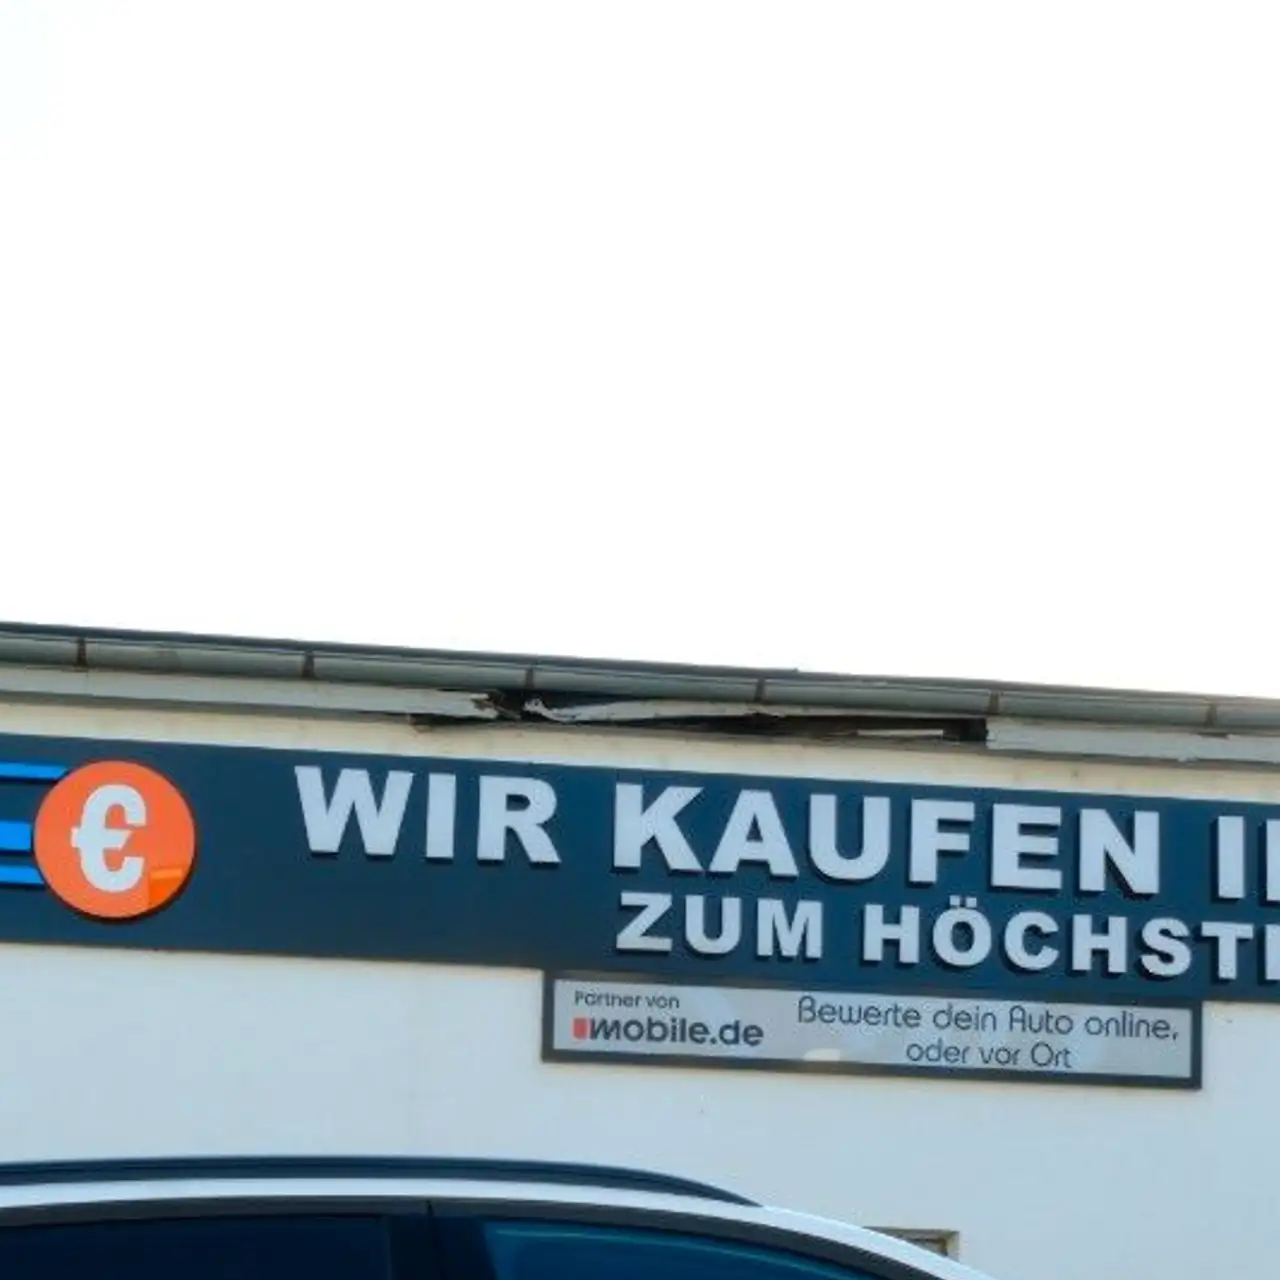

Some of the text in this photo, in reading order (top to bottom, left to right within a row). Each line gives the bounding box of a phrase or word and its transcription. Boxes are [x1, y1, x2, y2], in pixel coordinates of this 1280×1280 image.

[71, 784, 146, 892] €
[294, 766, 561, 863] WIR
[613, 783, 1160, 894] KAUFEN
[616, 892, 822, 959] ZUM
[574, 990, 680, 1009] Partner von
[797, 996, 921, 1027] Bewerte
[933, 1004, 997, 1032] dein
[1009, 1006, 1074, 1036] Auto
[589, 1016, 764, 1047] mobile.de
[906, 1038, 1073, 1069] oder vor Ort
